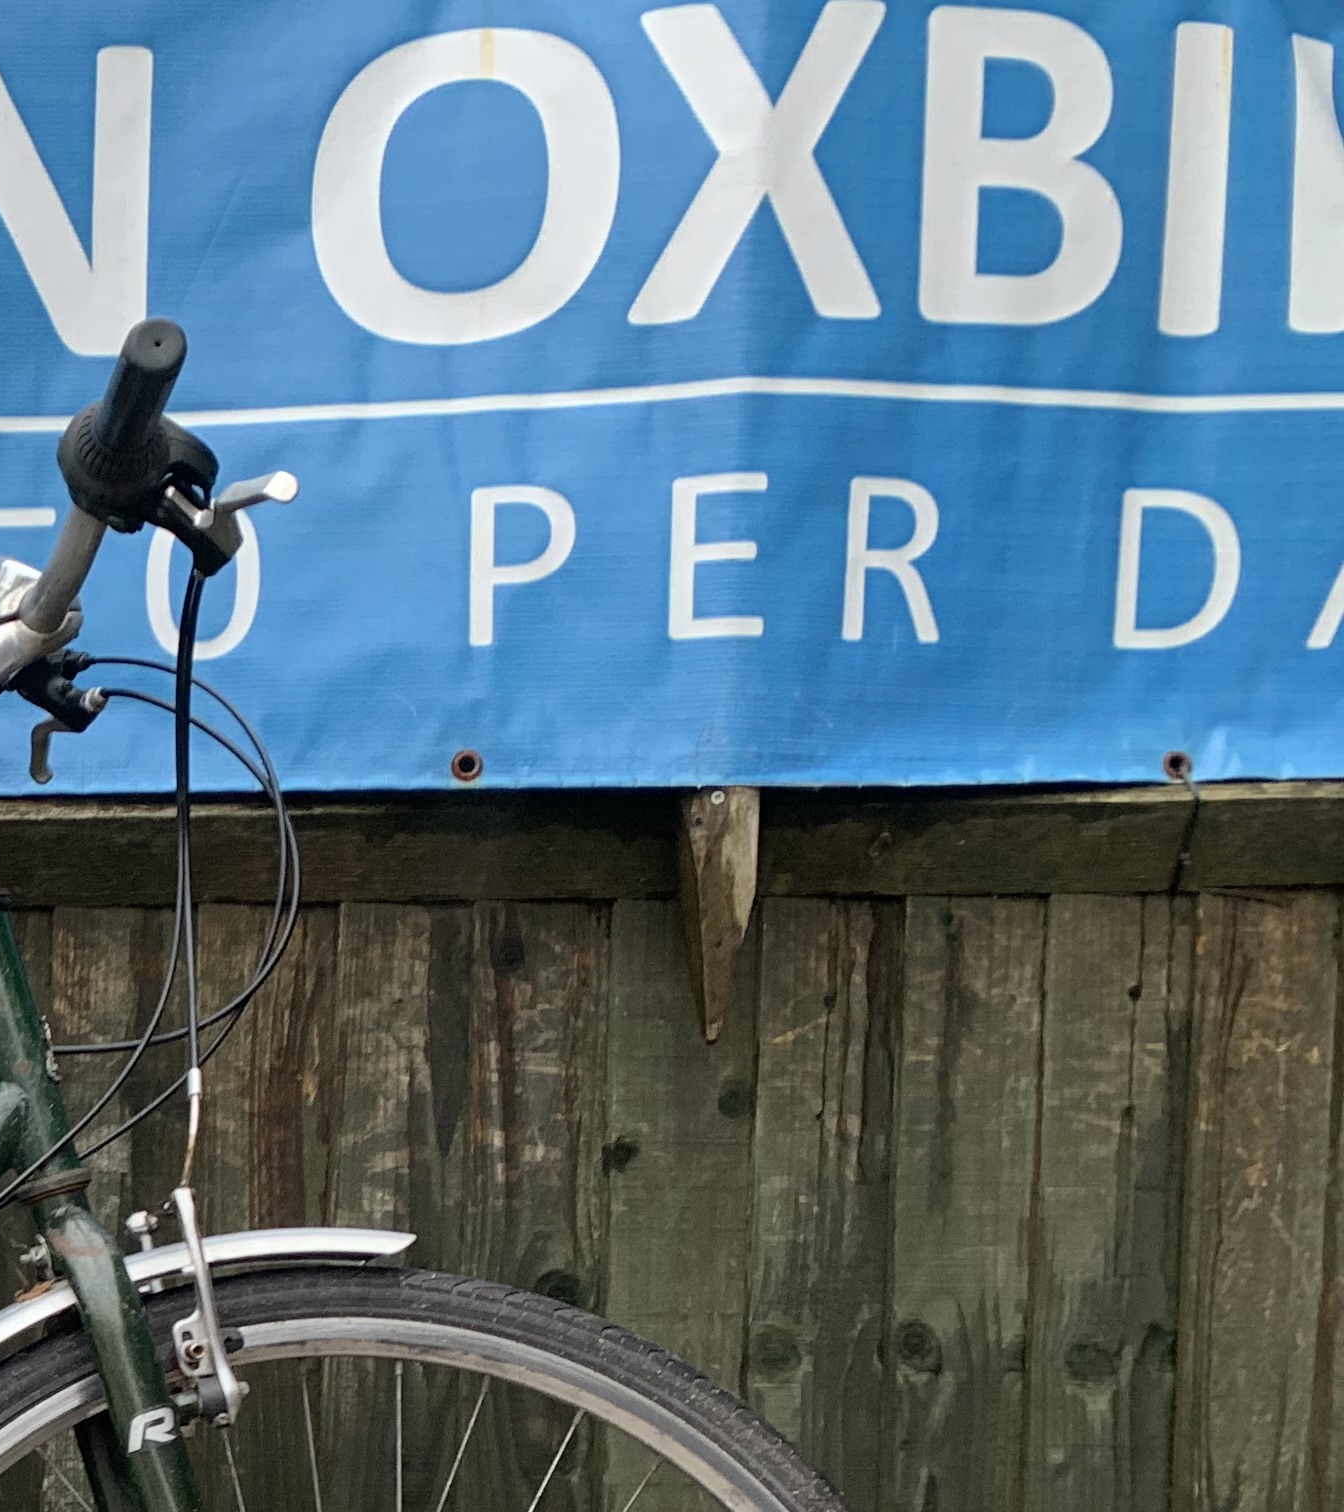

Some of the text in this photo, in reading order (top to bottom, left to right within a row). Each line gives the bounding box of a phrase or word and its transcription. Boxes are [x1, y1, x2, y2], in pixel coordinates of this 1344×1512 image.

[311, 0, 1344, 346] OXBI
[468, 471, 939, 647] PER
[1113, 488, 1344, 650] D
[127, 1406, 178, 1454] R
